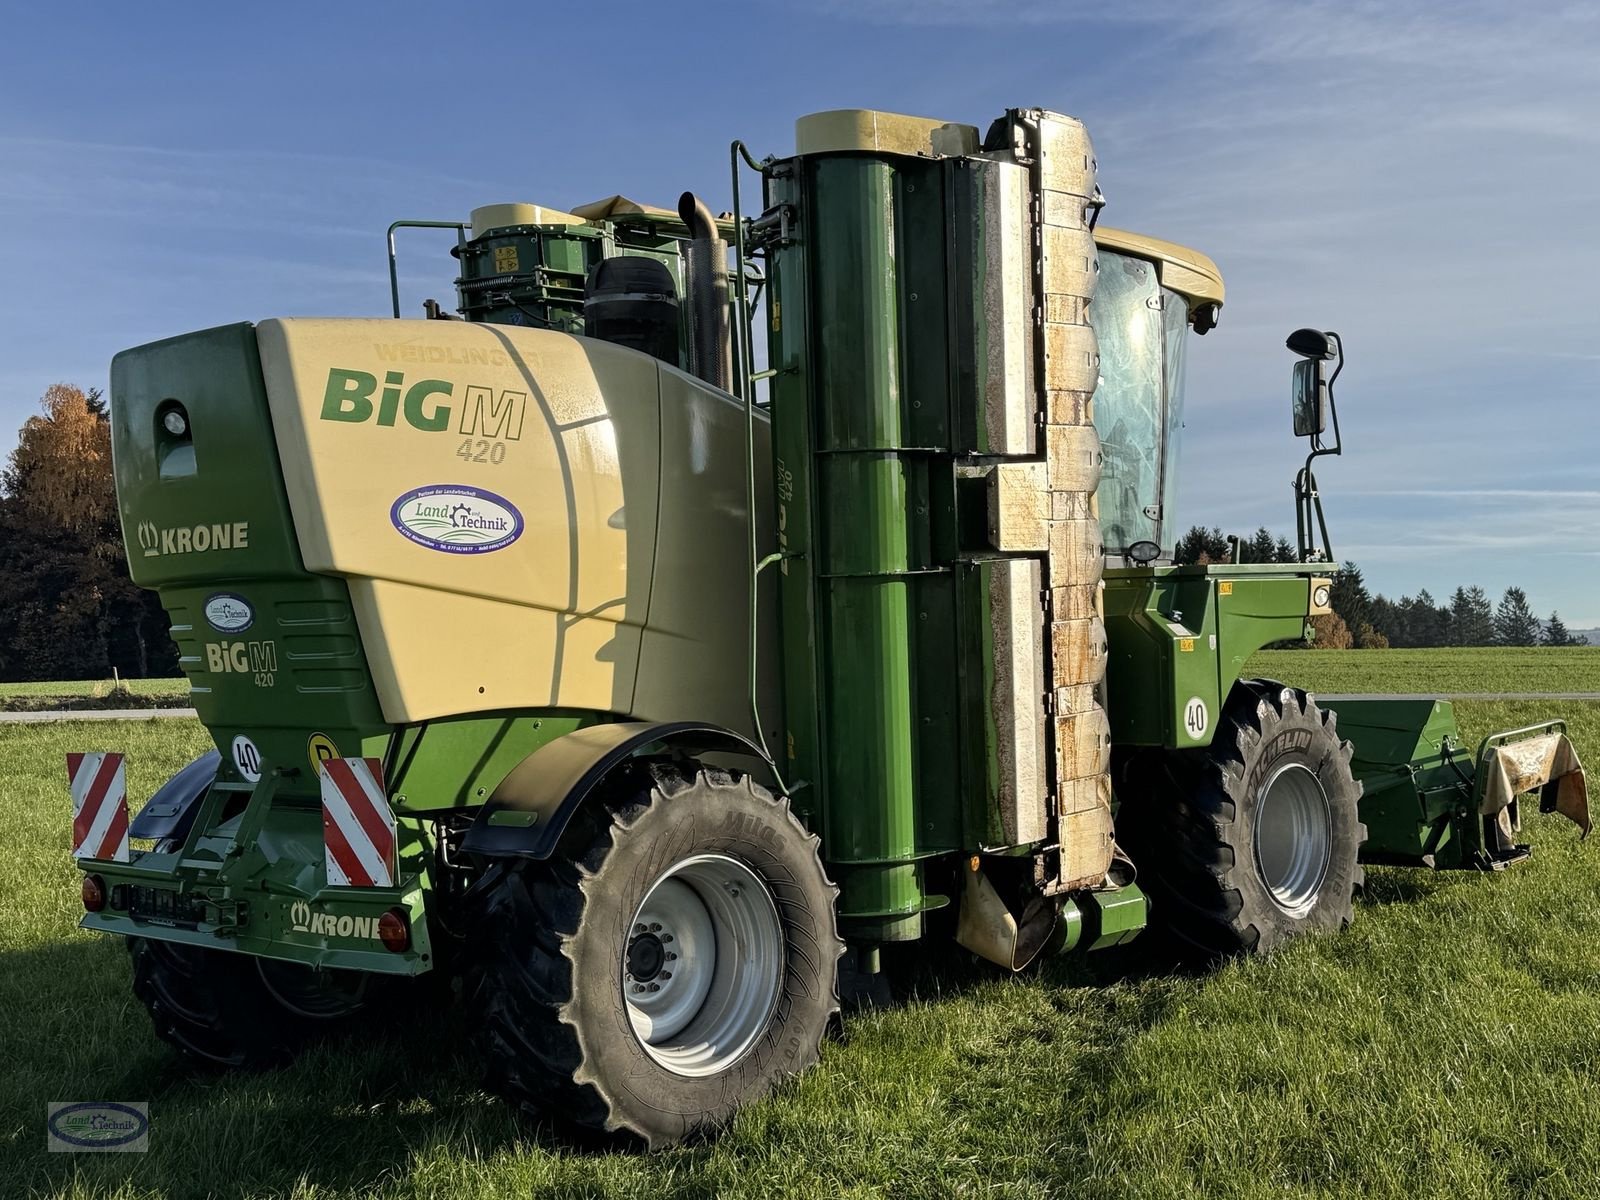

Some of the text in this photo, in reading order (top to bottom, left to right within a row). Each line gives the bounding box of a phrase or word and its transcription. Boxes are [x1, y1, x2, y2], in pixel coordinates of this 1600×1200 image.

[456, 439, 506, 465] 420
[415, 503, 449, 518] Land
[460, 514, 508, 531] Technik
[161, 522, 249, 555] KRONE
[254, 672, 274, 687] 420
[1188, 704, 1204, 732] 40
[236, 743, 259, 775] 40
